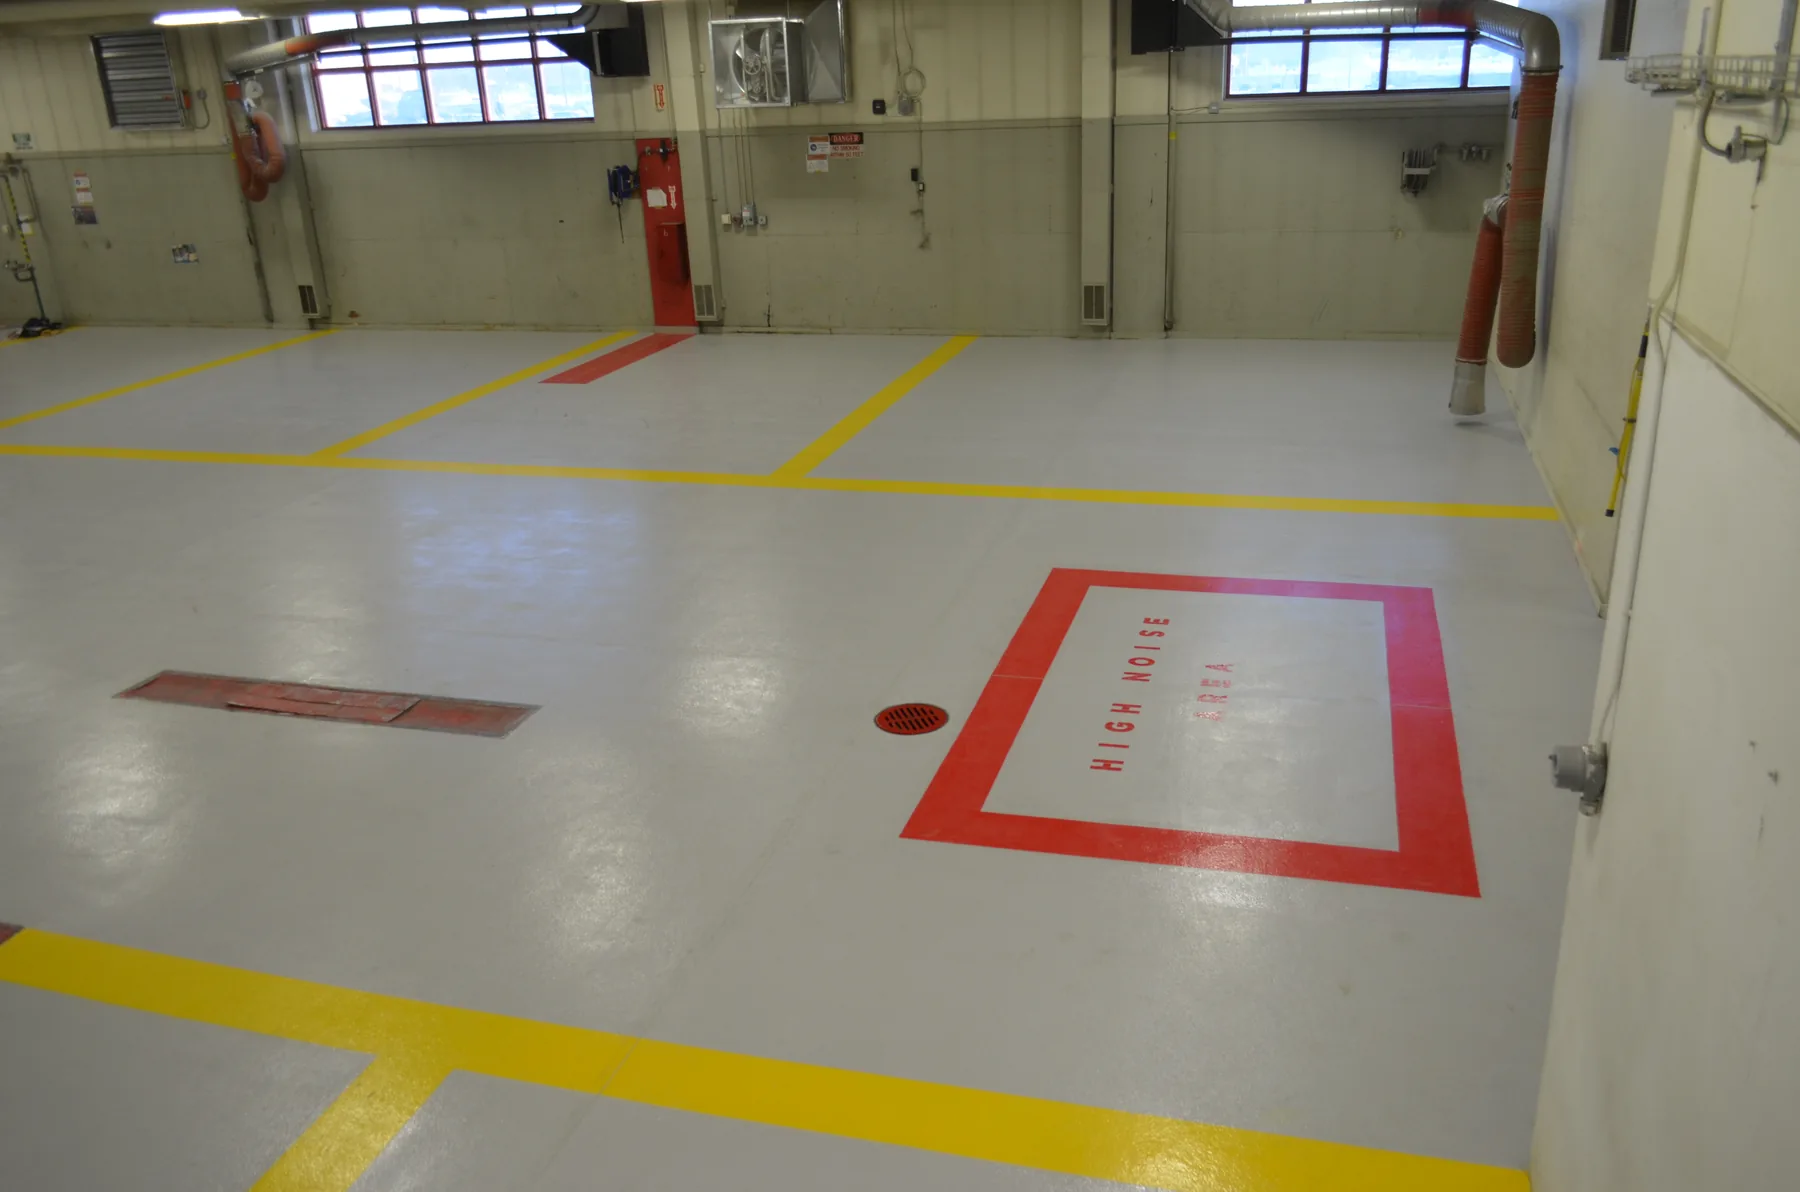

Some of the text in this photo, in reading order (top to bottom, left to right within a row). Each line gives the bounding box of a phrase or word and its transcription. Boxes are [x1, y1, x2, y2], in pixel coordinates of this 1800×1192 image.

[833, 135, 860, 143] DANGER
[1089, 617, 1170, 772] HIGH NOISE
[1193, 663, 1234, 722] AREA
